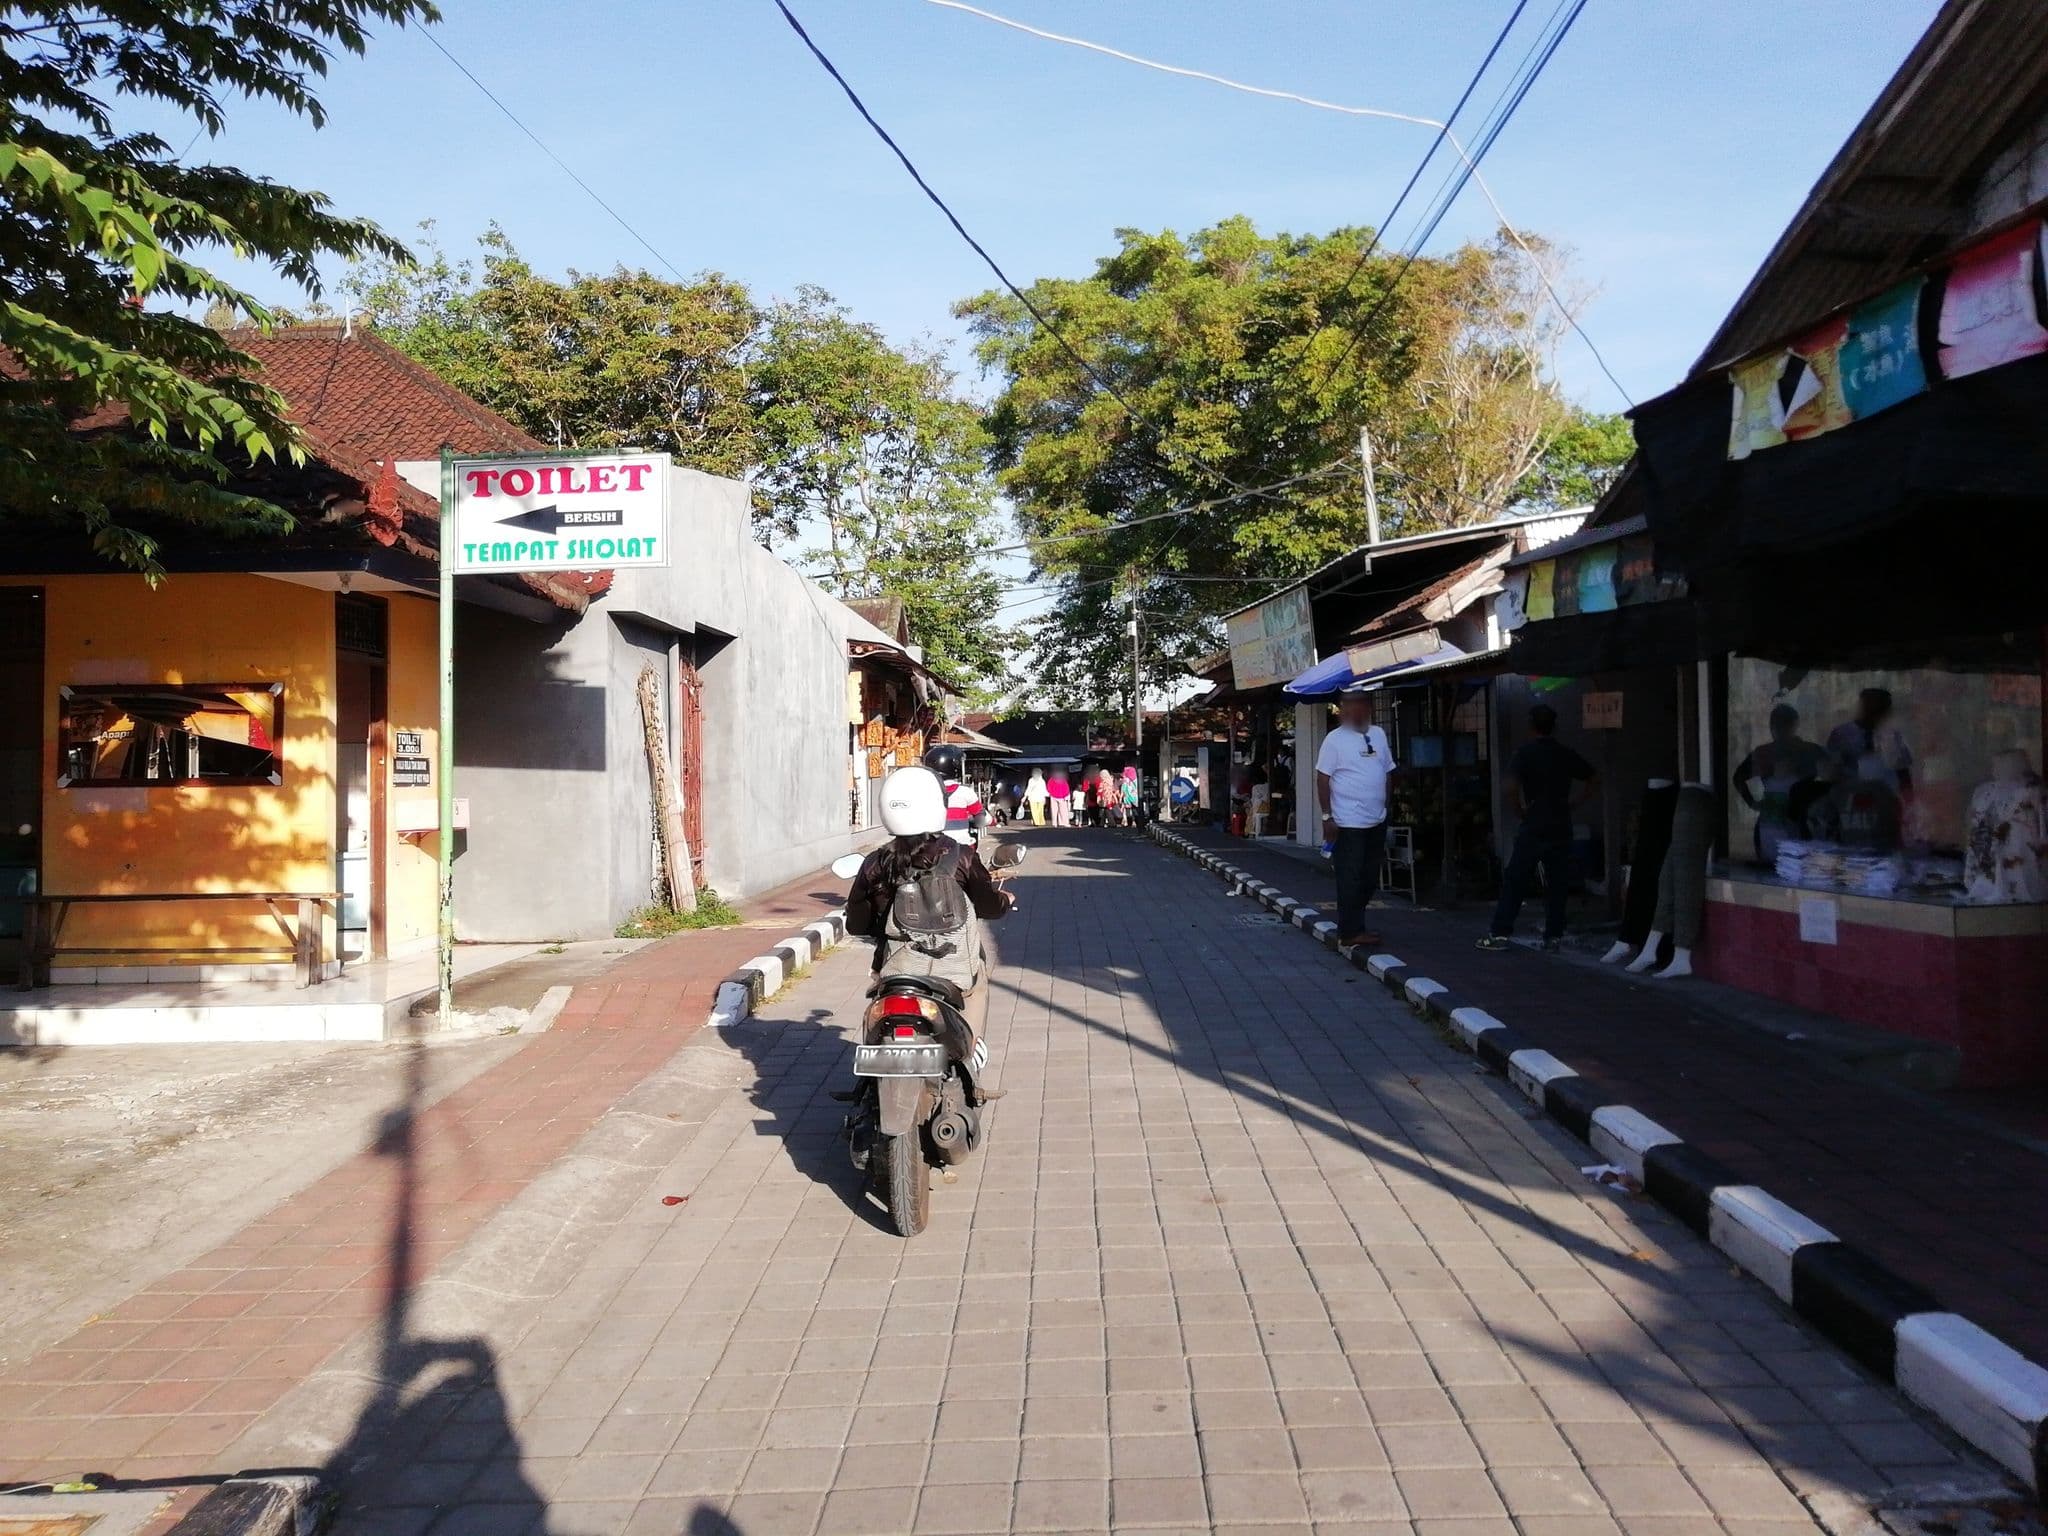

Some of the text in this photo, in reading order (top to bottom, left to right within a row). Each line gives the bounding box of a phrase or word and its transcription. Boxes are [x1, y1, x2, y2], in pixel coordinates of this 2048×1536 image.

[466, 464, 651, 498] TOILET
[564, 512, 617, 524] BERSIH
[463, 537, 657, 563] TEMPAT SHOLAT
[397, 734, 420, 746] TOILET
